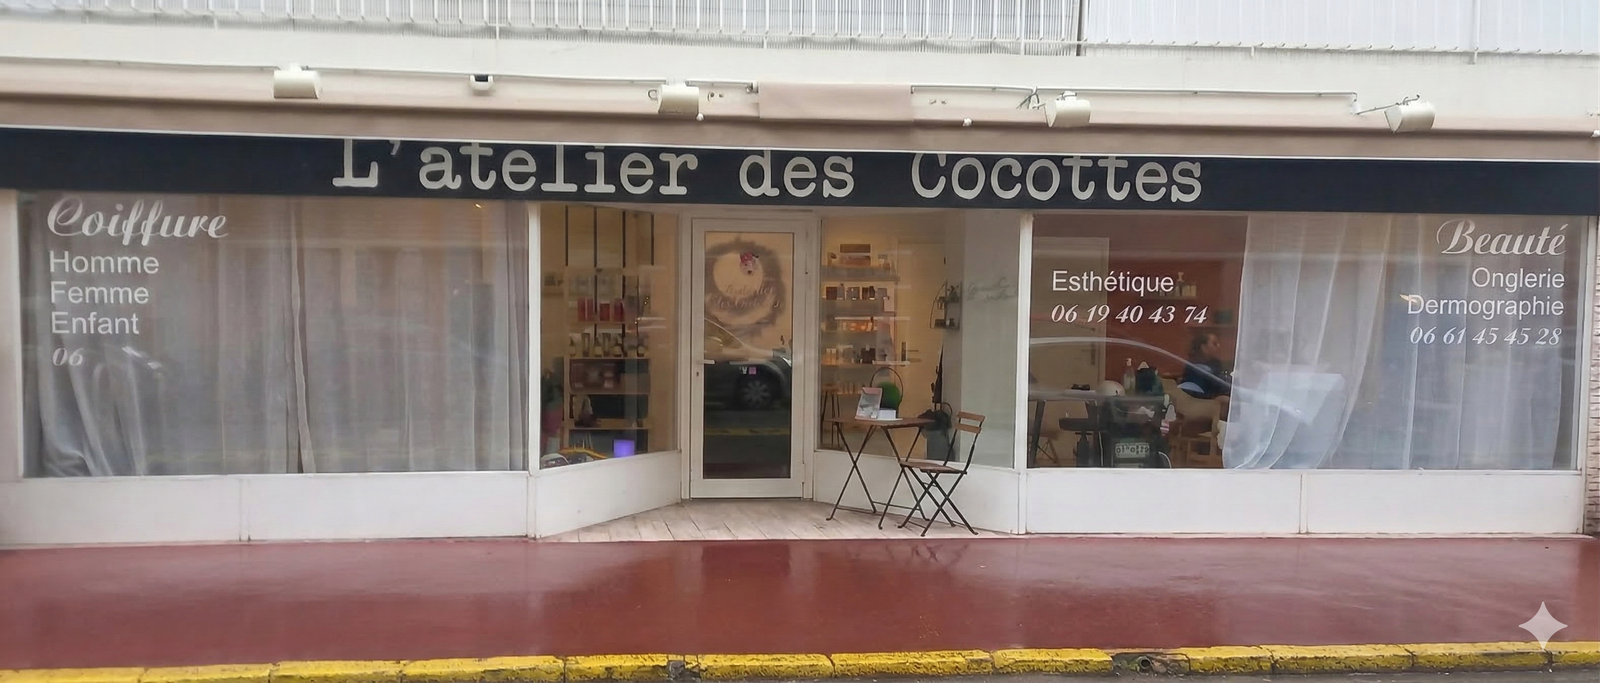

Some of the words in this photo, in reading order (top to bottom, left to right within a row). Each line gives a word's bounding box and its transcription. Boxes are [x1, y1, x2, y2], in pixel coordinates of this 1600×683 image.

[332, 139, 698, 196] L'atelier
[739, 150, 855, 198] des
[911, 153, 1201, 203] Cocottes
[47, 197, 228, 247] Coiffure
[1436, 219, 1569, 256] Beauté
[50, 251, 159, 274] Homme
[51, 281, 149, 304] Femme
[1052, 270, 1174, 297] Esthétique
[1472, 267, 1565, 293] Onglerie
[1051, 304, 1079, 323] 06
[1086, 304, 1110, 323] 19
[1115, 305, 1143, 323] 40
[1148, 305, 1176, 324] 43
[1184, 306, 1208, 324] 74
[1408, 294, 1564, 320] Dermographie
[51, 311, 139, 335] Enfant
[1410, 326, 1437, 344] 06
[1443, 326, 1466, 345] 61
[1472, 327, 1499, 345] 45
[1504, 327, 1531, 345] 45
[1535, 328, 1562, 345] 28
[53, 347, 84, 366] 06
